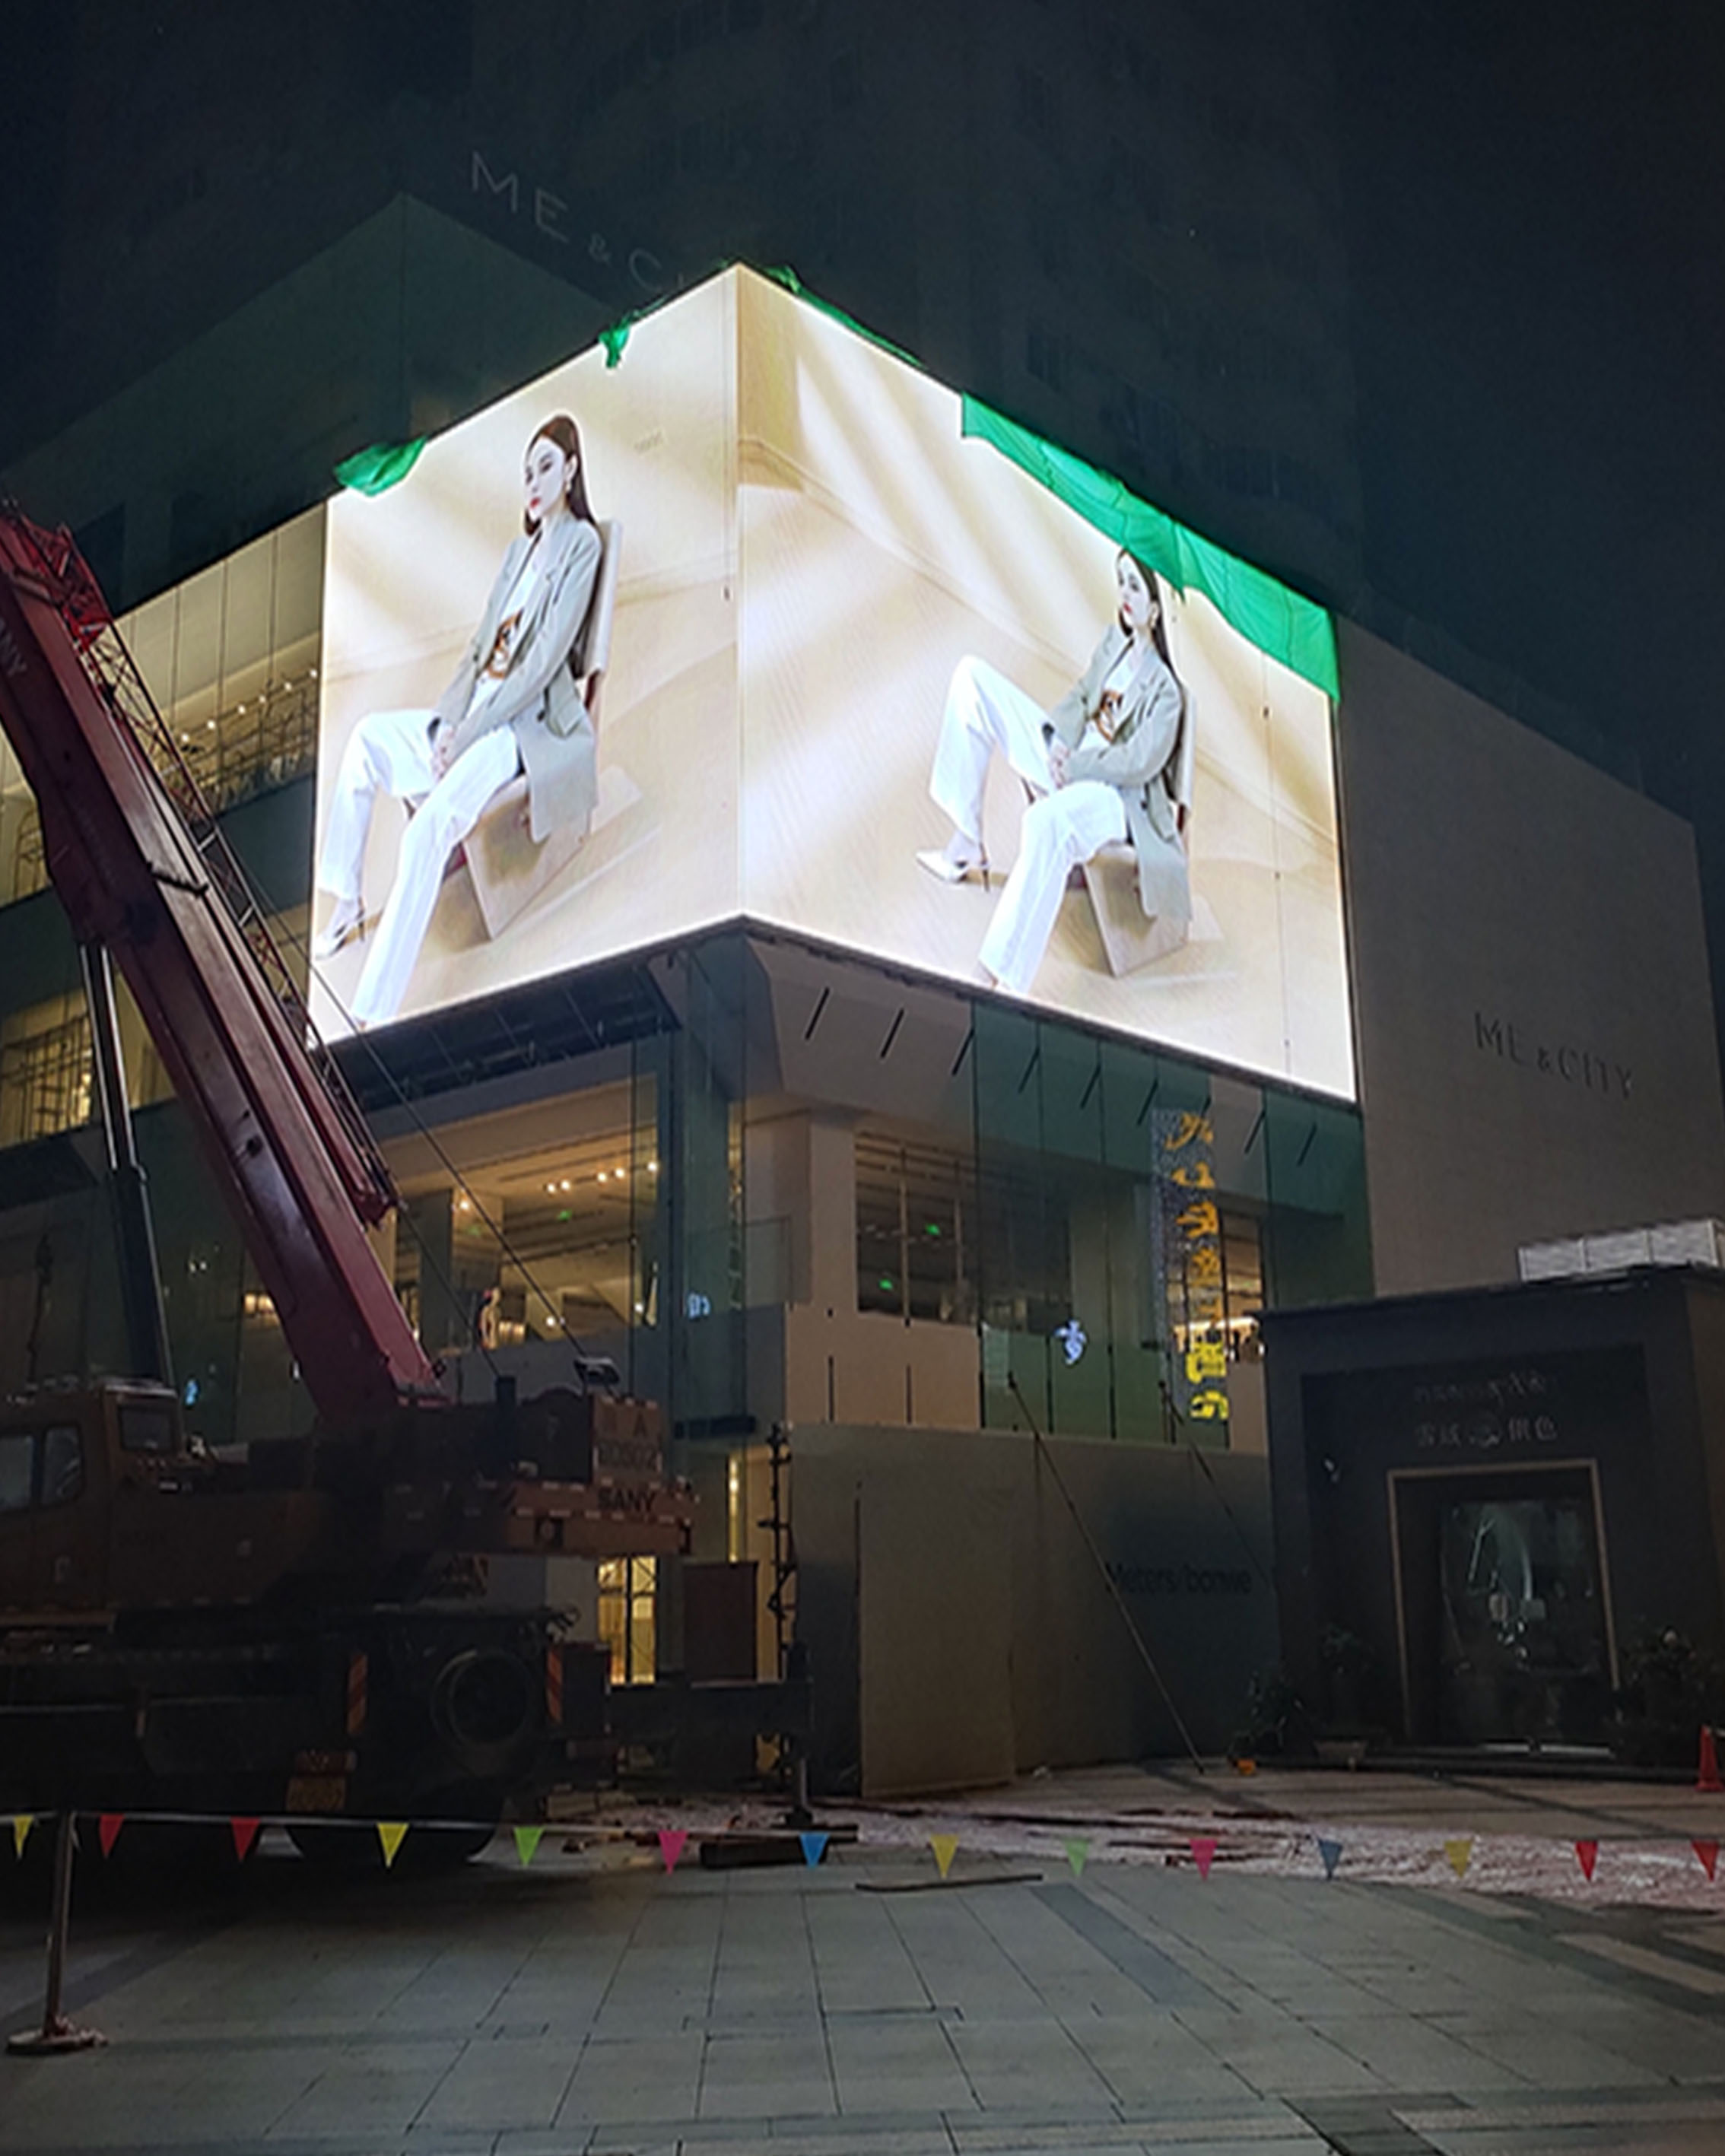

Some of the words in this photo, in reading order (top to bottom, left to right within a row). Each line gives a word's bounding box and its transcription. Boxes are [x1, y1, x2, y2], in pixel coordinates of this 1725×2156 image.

[472, 151, 569, 244] ME
[1558, 1046, 1632, 1098] CITY
[598, 1488, 656, 1512] SANY
